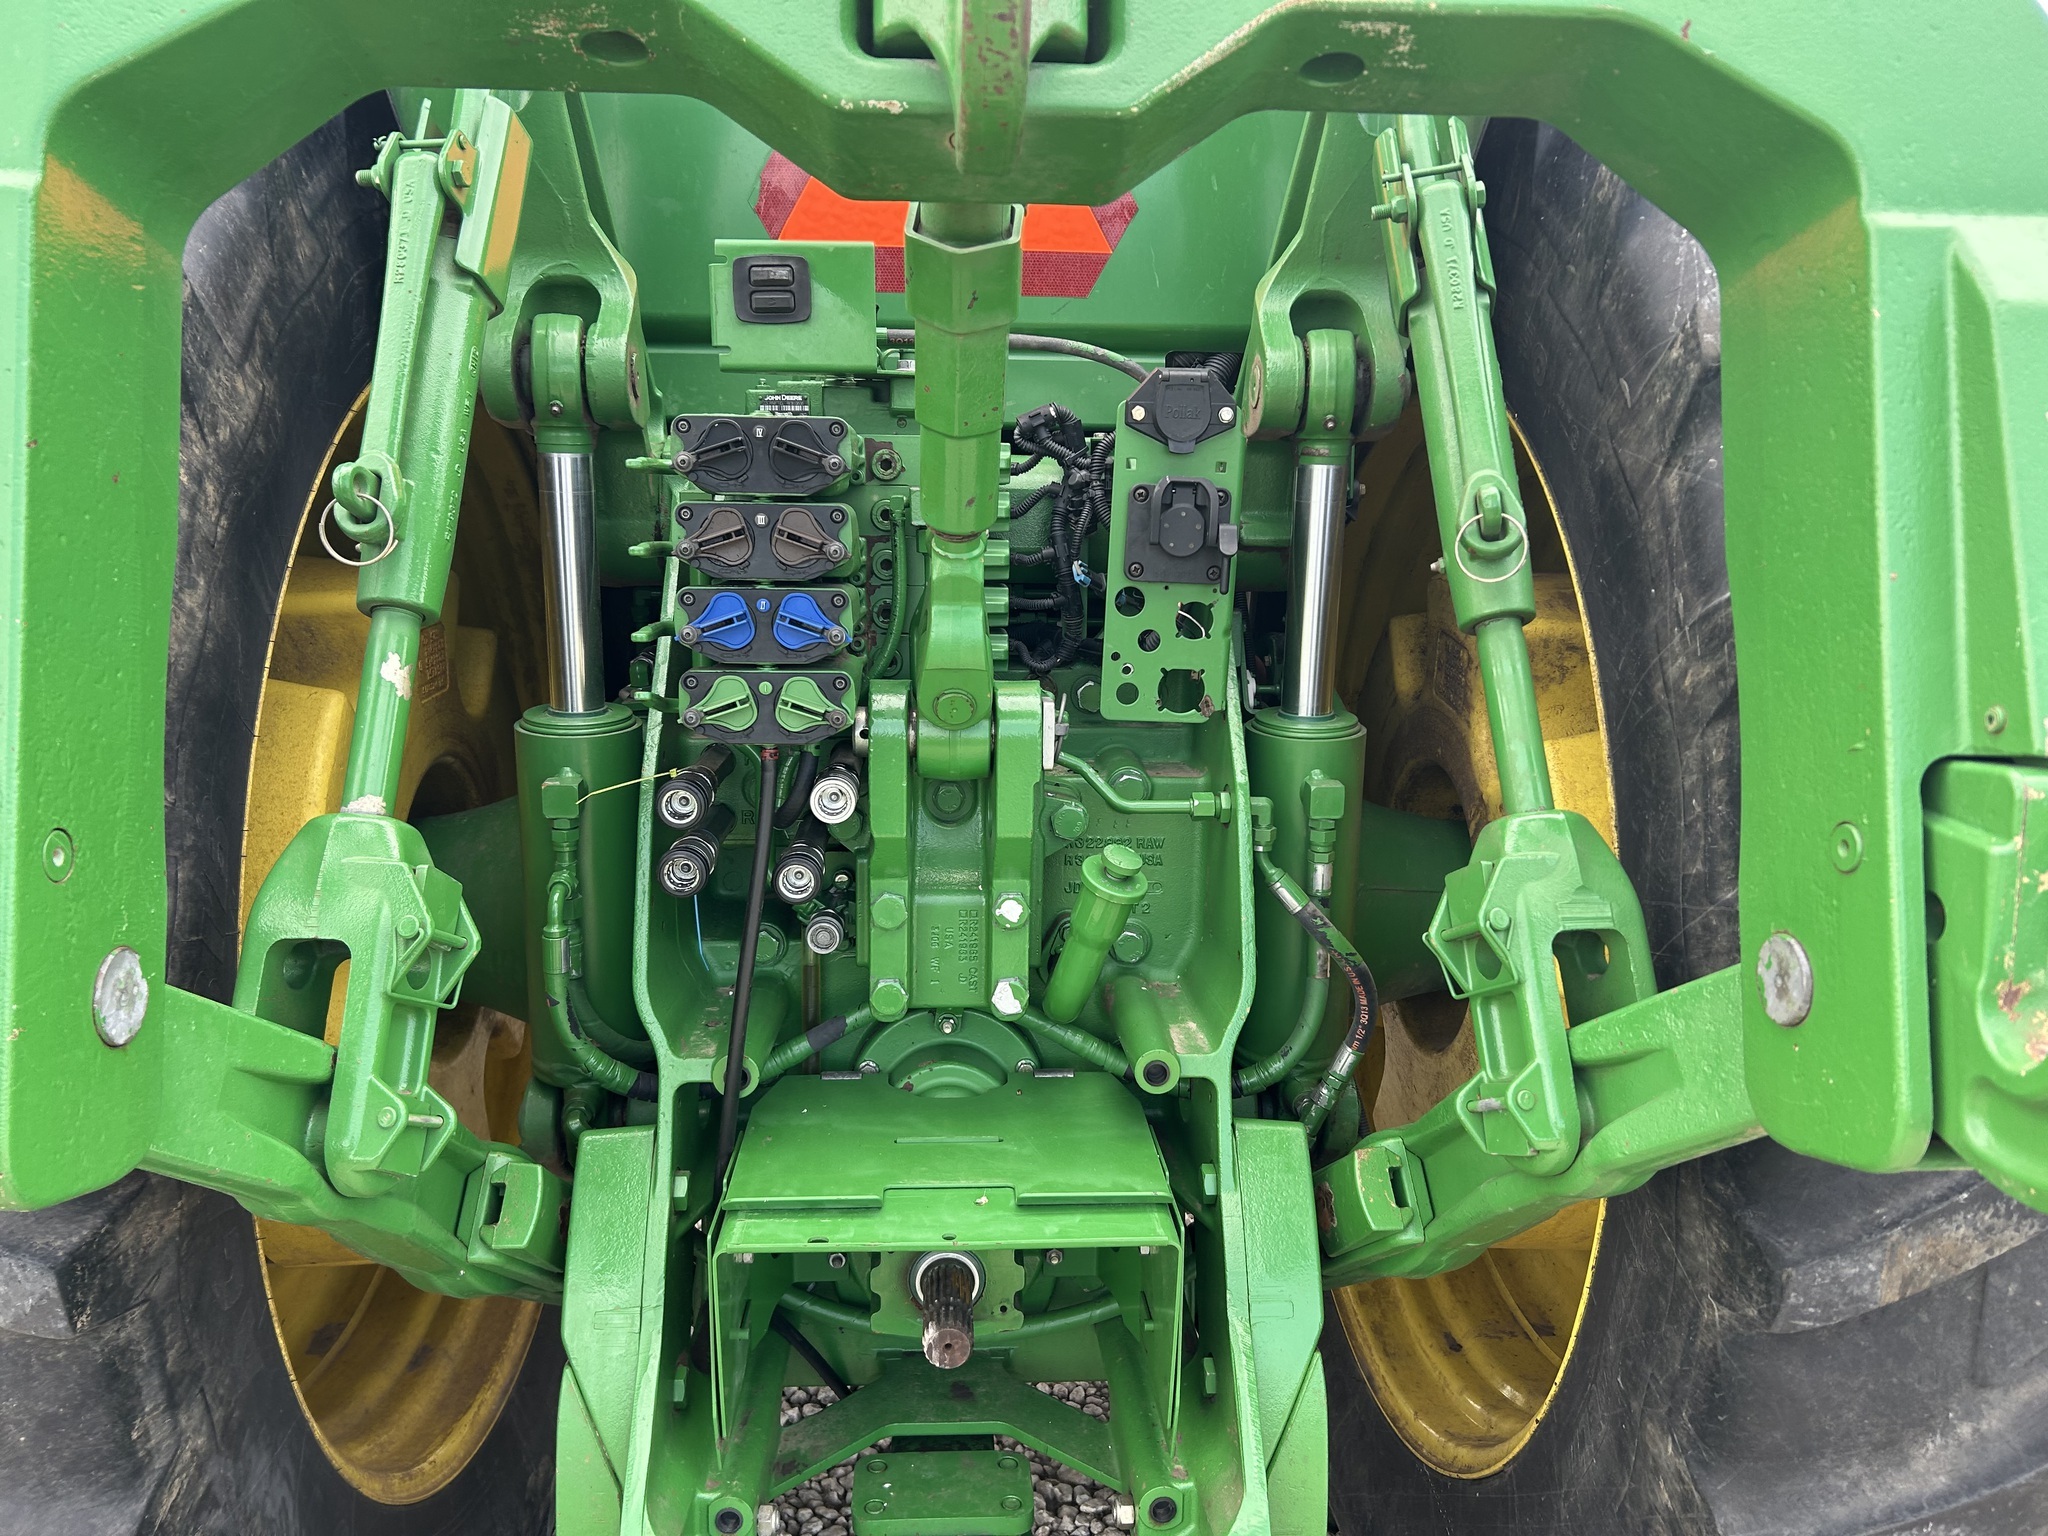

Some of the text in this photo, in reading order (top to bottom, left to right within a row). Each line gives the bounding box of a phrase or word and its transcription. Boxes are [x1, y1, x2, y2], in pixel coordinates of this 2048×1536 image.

[402, 179, 416, 204] USA
[1439, 207, 1454, 233] USA
[1164, 404, 1201, 420] Pollak
[1136, 837, 1166, 850] RAW
[943, 926, 954, 950] USA
[968, 966, 979, 994] CAST
[1355, 985, 1368, 1006] MADE
